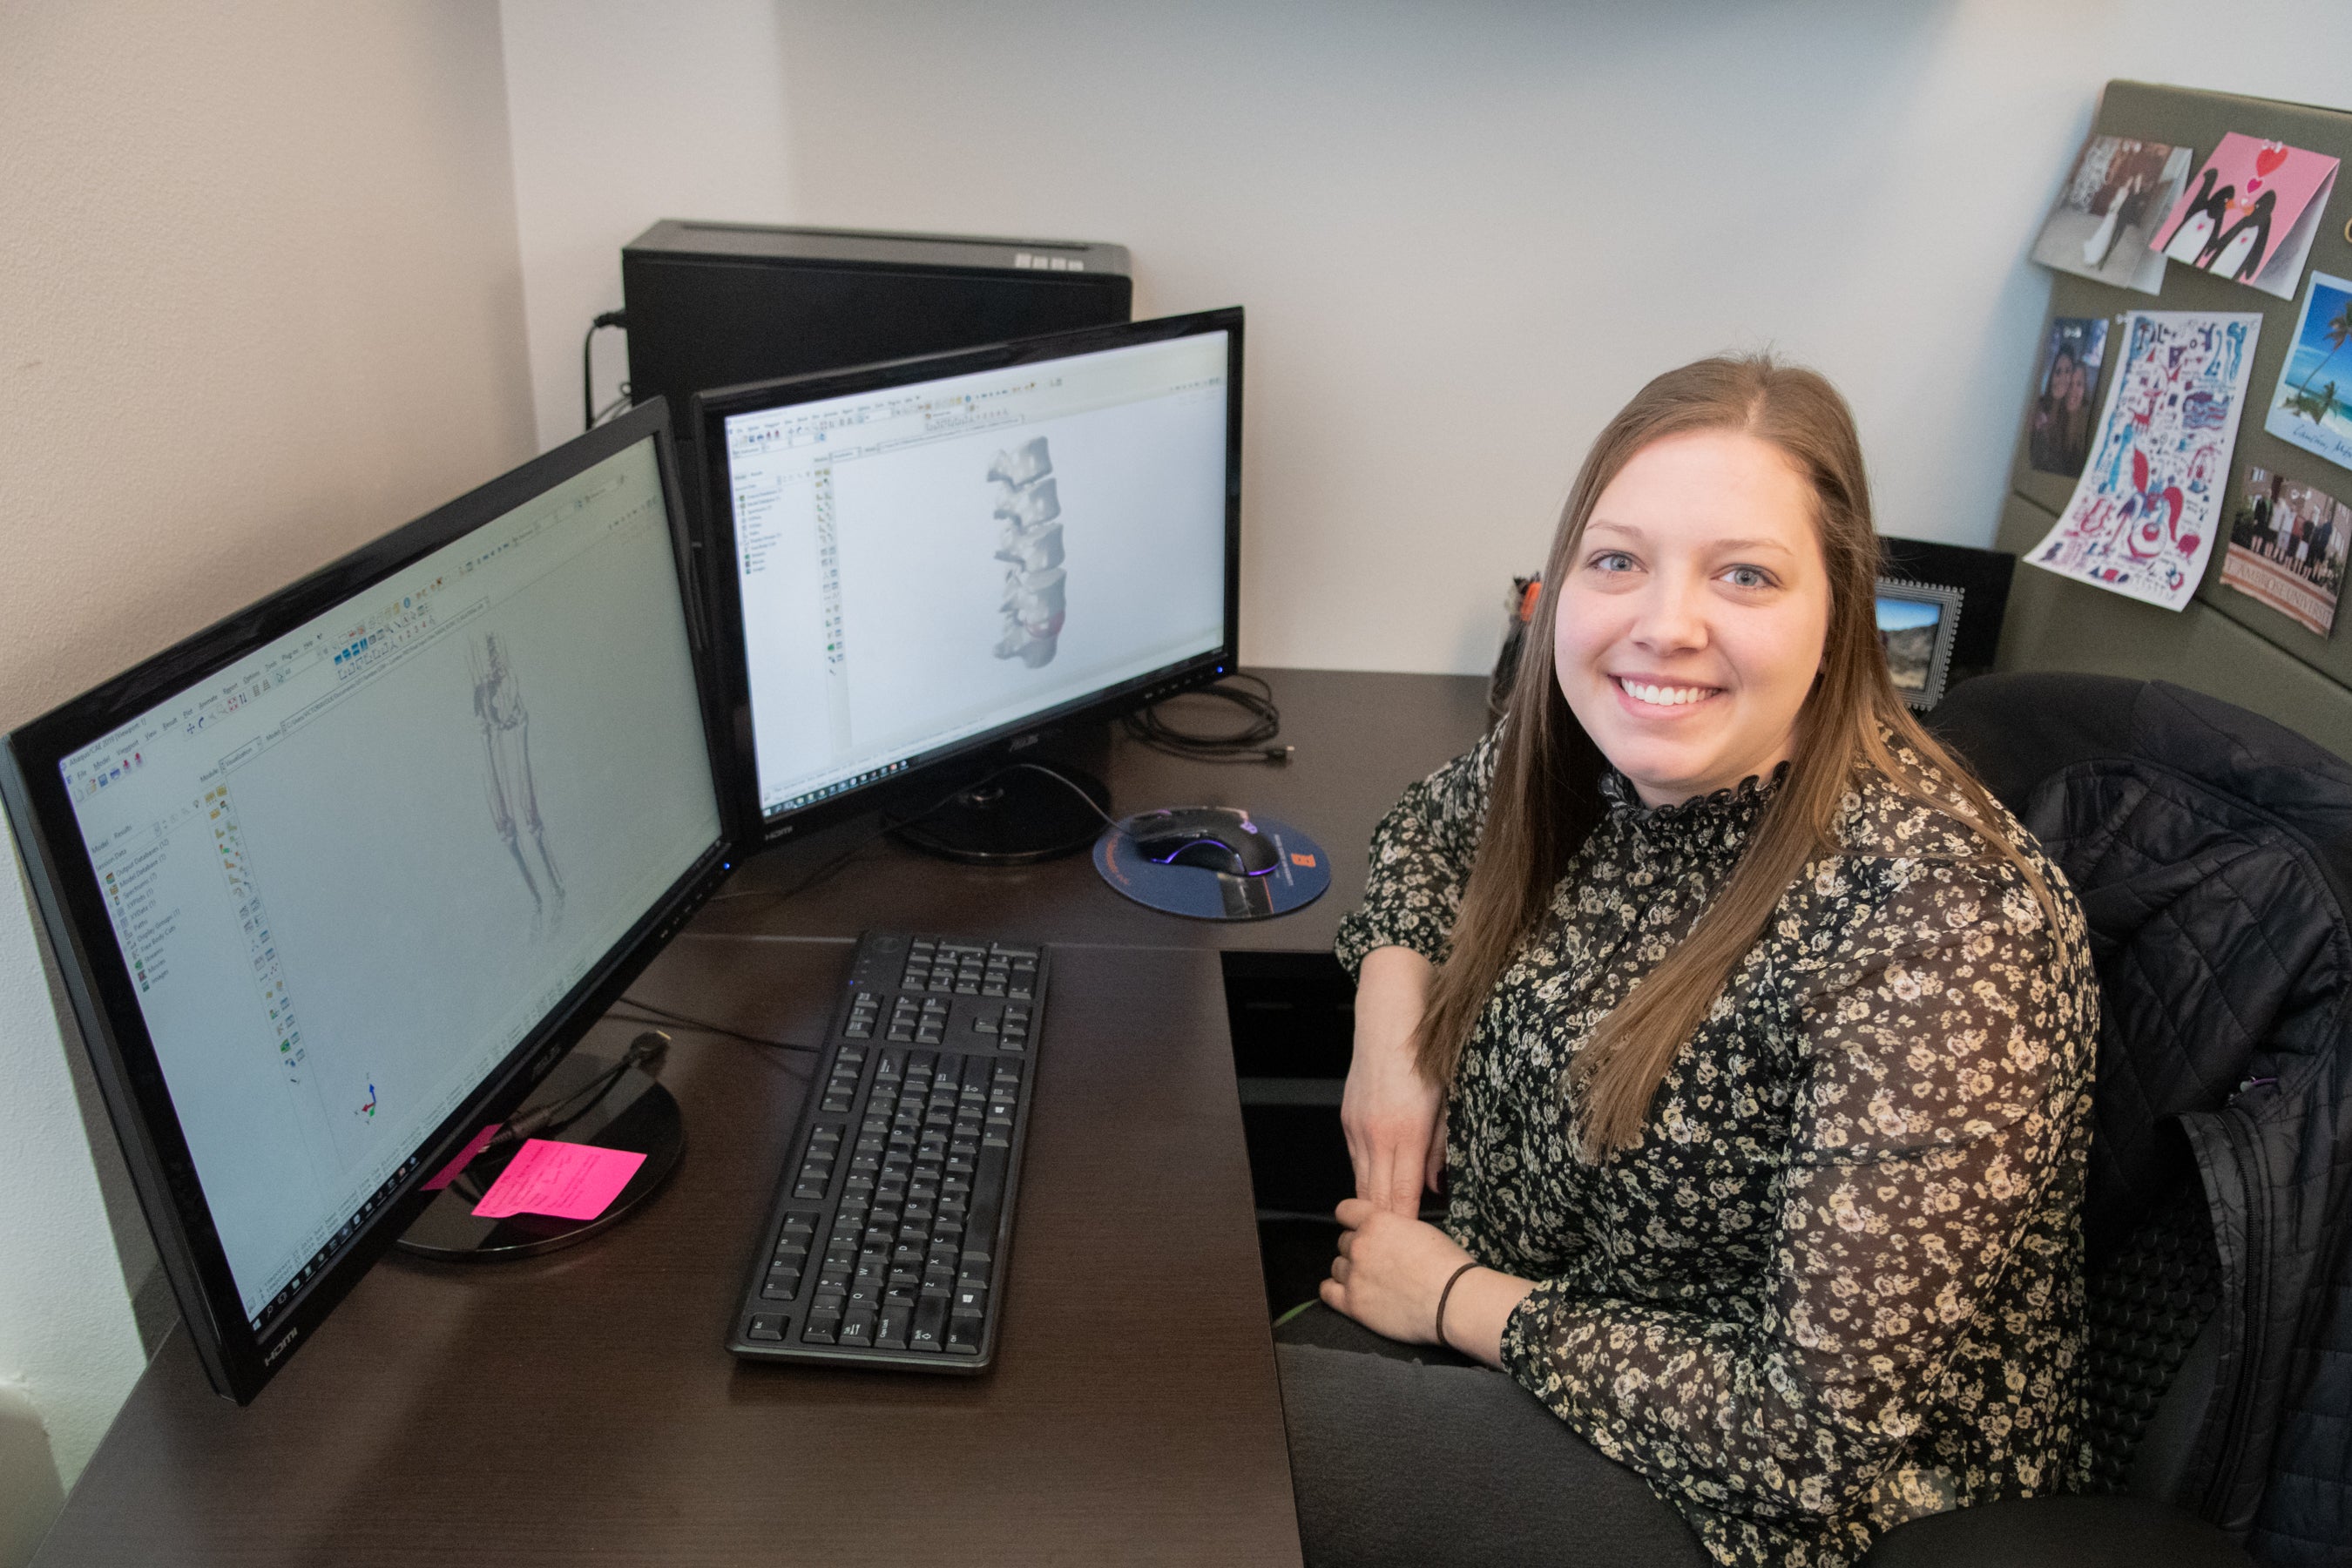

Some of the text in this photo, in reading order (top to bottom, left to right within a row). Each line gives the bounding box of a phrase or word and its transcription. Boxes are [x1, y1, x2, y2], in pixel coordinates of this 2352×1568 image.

[77, 770, 87, 781] File
[93, 756, 111, 771] Model
[116, 740, 139, 756] Viewport
[145, 730, 157, 740] View
[162, 718, 177, 731] Result
[183, 709, 193, 719] Plot
[91, 825, 132, 854] Model Results
[114, 848, 127, 862] Data
[116, 861, 134, 877] Output
[134, 845, 159, 866] Databases
[119, 873, 136, 888] Model
[136, 859, 159, 878] Database
[123, 879, 149, 899] Spectrums
[133, 919, 148, 932] Paths
[137, 927, 155, 943] Display
[155, 915, 173, 930] Groups
[141, 925, 176, 953] Free Body Cuts
[144, 946, 164, 963] Streams
[148, 958, 166, 973] Movies
[264, 1326, 298, 1367] HDMI
